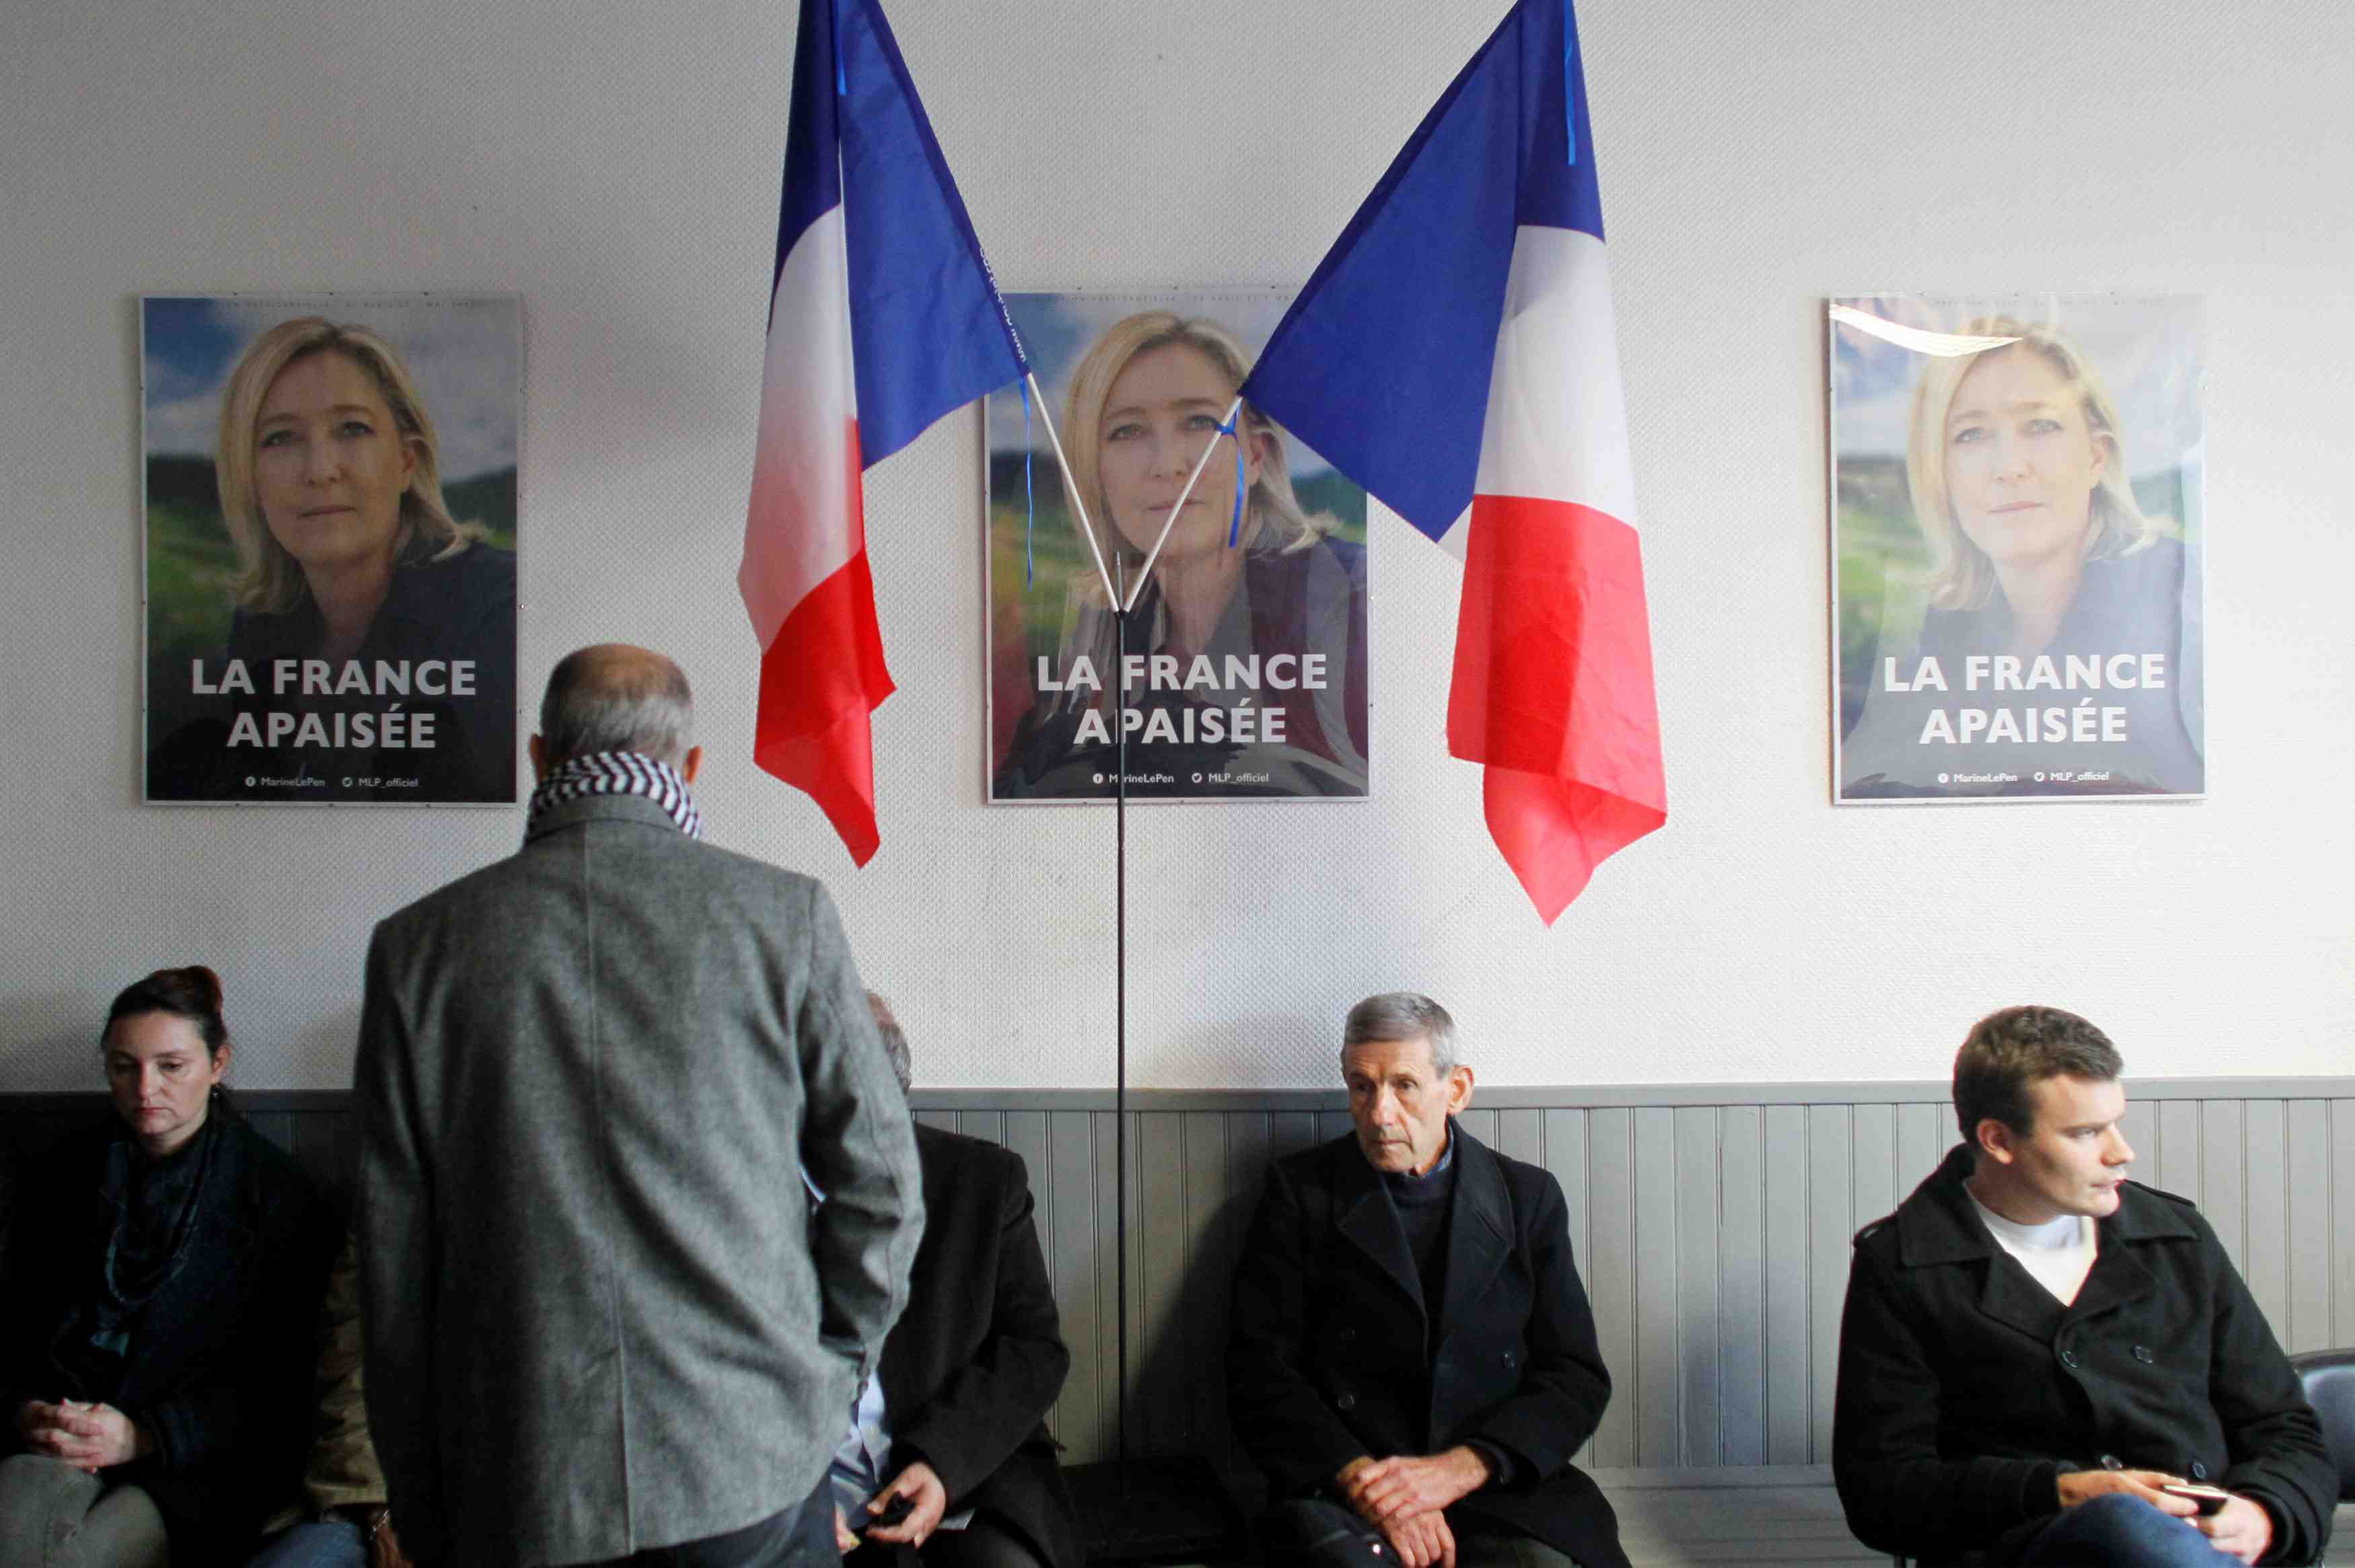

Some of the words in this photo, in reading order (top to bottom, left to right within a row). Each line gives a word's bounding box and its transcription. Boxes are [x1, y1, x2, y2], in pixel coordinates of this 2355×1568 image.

[192, 659, 255, 694] LA
[274, 659, 476, 696] FRANCE
[1038, 655, 1101, 691] LA
[1121, 654, 1327, 690] FRANCE
[1885, 656, 1949, 692] LA
[1966, 653, 2166, 691] FRANCE
[227, 703, 435, 748] APAISÉE
[1073, 698, 1286, 744] APAISÉE
[1919, 697, 2127, 744] APAISÉE
[261, 777, 325, 786] MarineLePen
[358, 778, 419, 788] MLP_officiel
[1109, 774, 1174, 784] MrineLePen
[1208, 772, 1270, 784] MLP_officiel
[1953, 774, 2017, 782] MarineLePen
[2050, 772, 2109, 782] MLP_officiel
